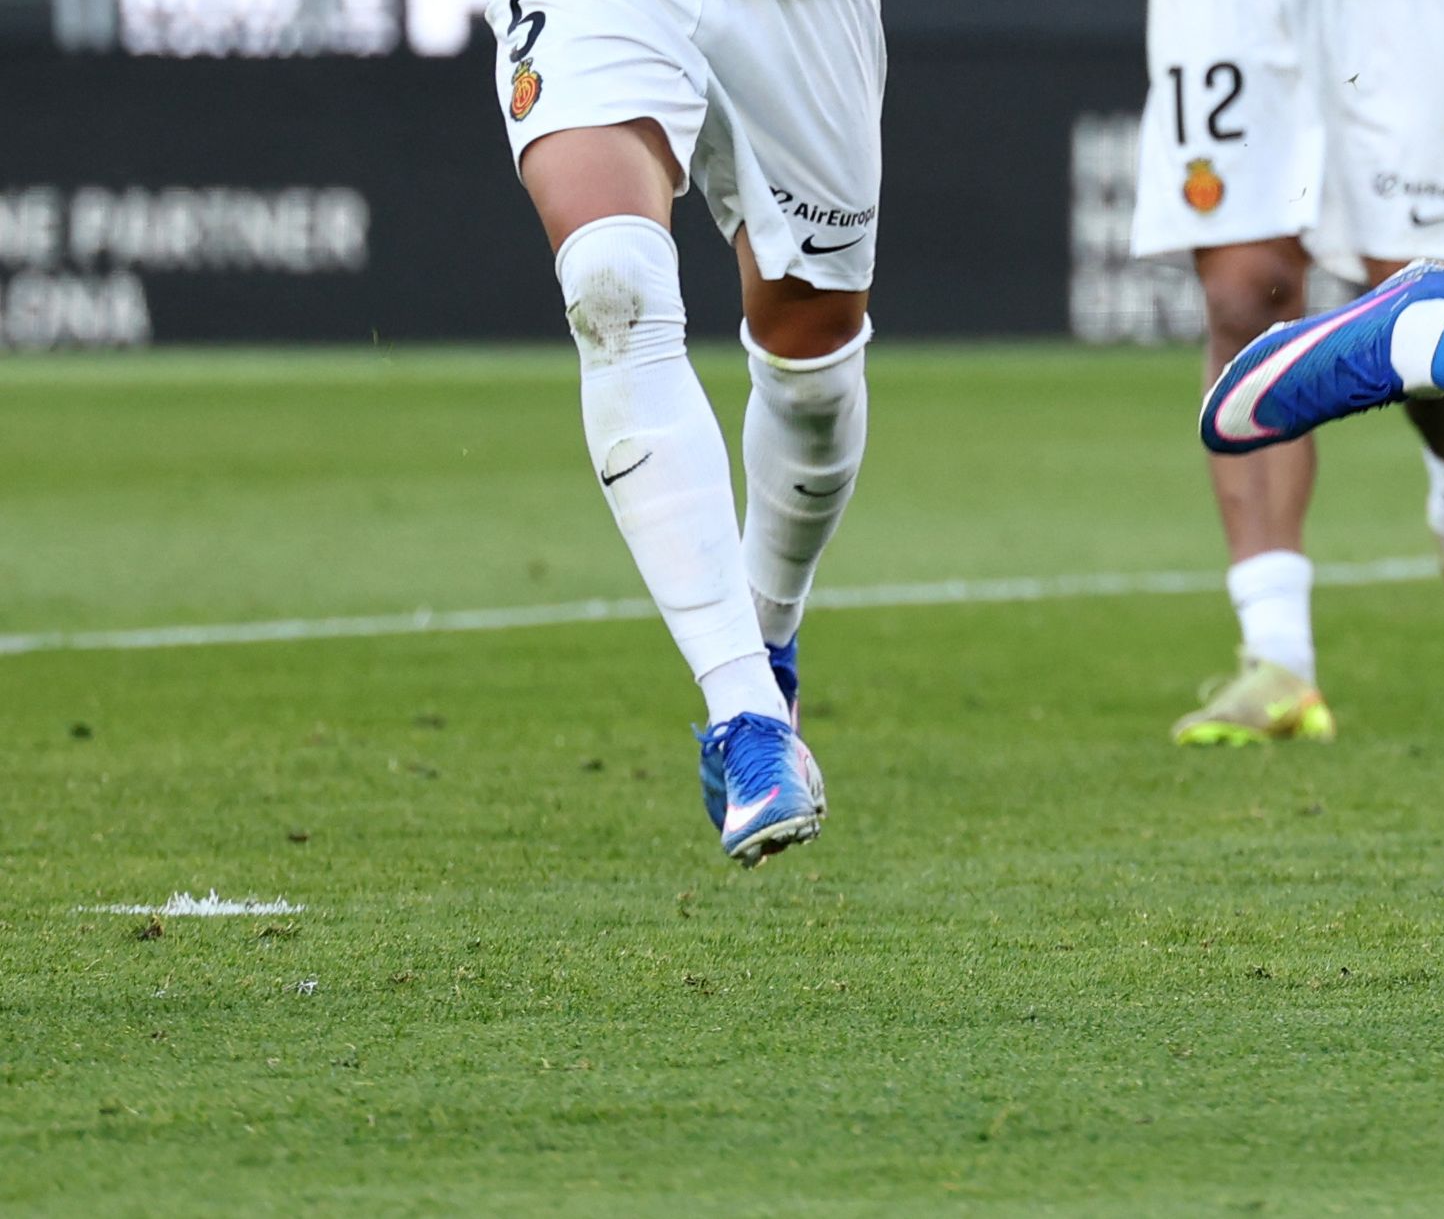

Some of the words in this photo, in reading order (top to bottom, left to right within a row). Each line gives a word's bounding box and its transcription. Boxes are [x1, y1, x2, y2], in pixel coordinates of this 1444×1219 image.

[1168, 61, 1245, 146] 12
[70, 184, 372, 274] PARTNER
[794, 202, 876, 228] AirEuropa
